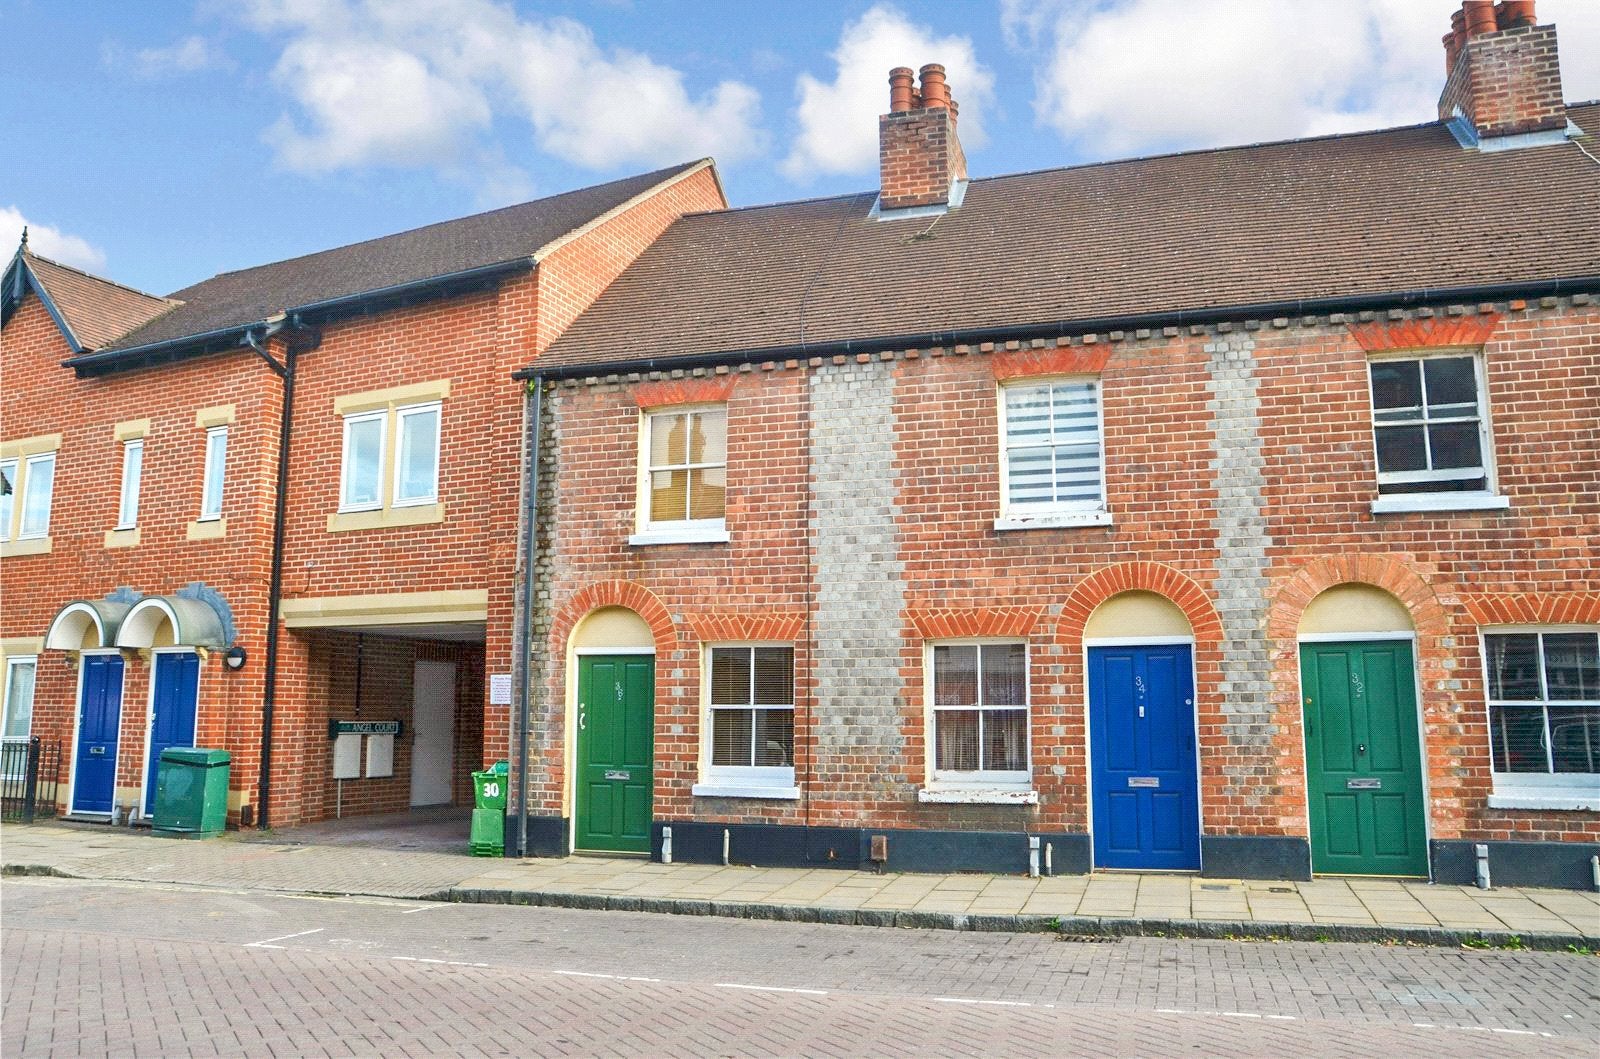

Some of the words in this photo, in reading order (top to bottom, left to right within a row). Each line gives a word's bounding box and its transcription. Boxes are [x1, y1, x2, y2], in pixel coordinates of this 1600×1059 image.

[1136, 675, 1146, 693] 34
[1352, 672, 1364, 693] 32
[352, 723, 372, 732] ANGEL
[374, 723, 395, 732] COURT
[483, 782, 500, 797] 30
